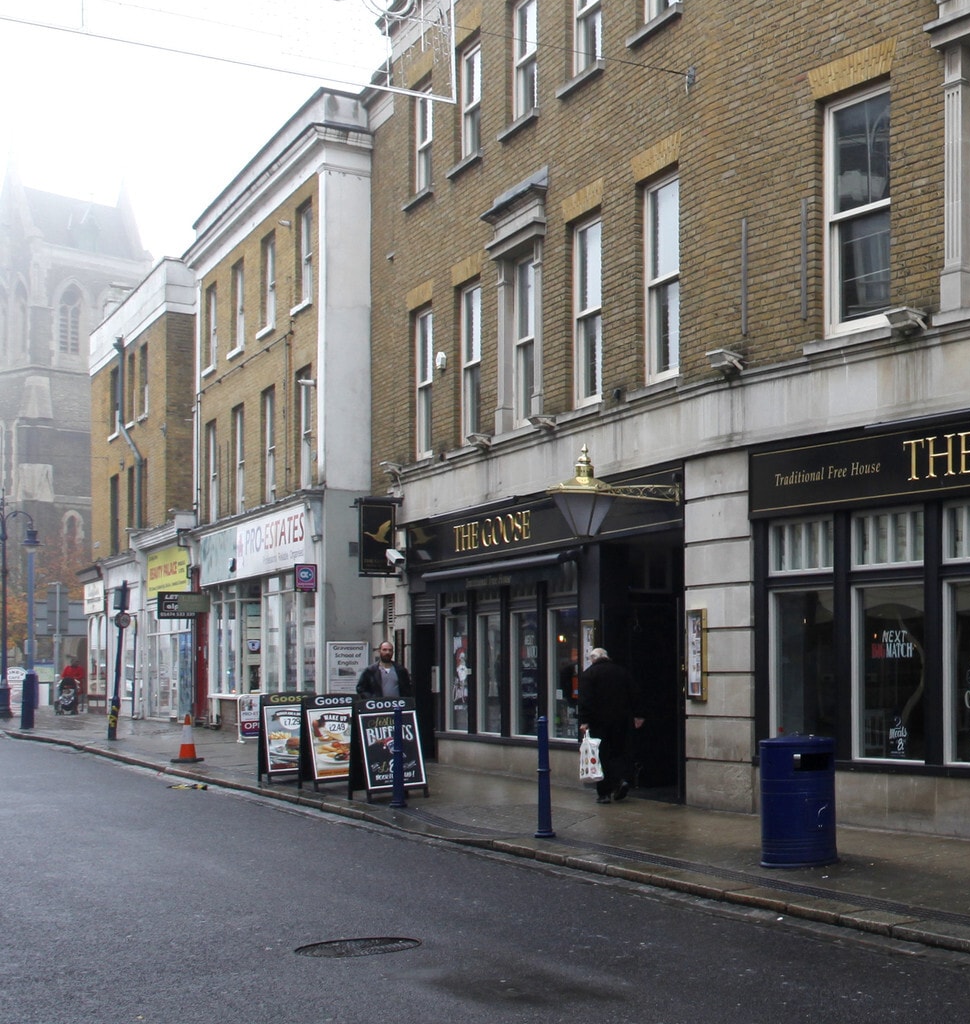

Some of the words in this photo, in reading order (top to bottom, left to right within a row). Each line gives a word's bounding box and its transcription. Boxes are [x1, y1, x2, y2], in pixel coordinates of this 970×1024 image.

[775, 466, 824, 487] Traditional
[828, 465, 847, 478] Free
[851, 461, 881, 476] House
[245, 512, 304, 556] PRO-ESTATES
[453, 521, 479, 552] THE
[482, 510, 531, 547] GOOSE
[882, 630, 907, 642] NEXT
[886, 642, 913, 658] MATCH
[270, 694, 304, 703] Goos
[315, 696, 352, 706] Goose
[366, 699, 406, 709] Goose
[244, 721, 259, 730] OP
[366, 724, 413, 747] BUFFTS
